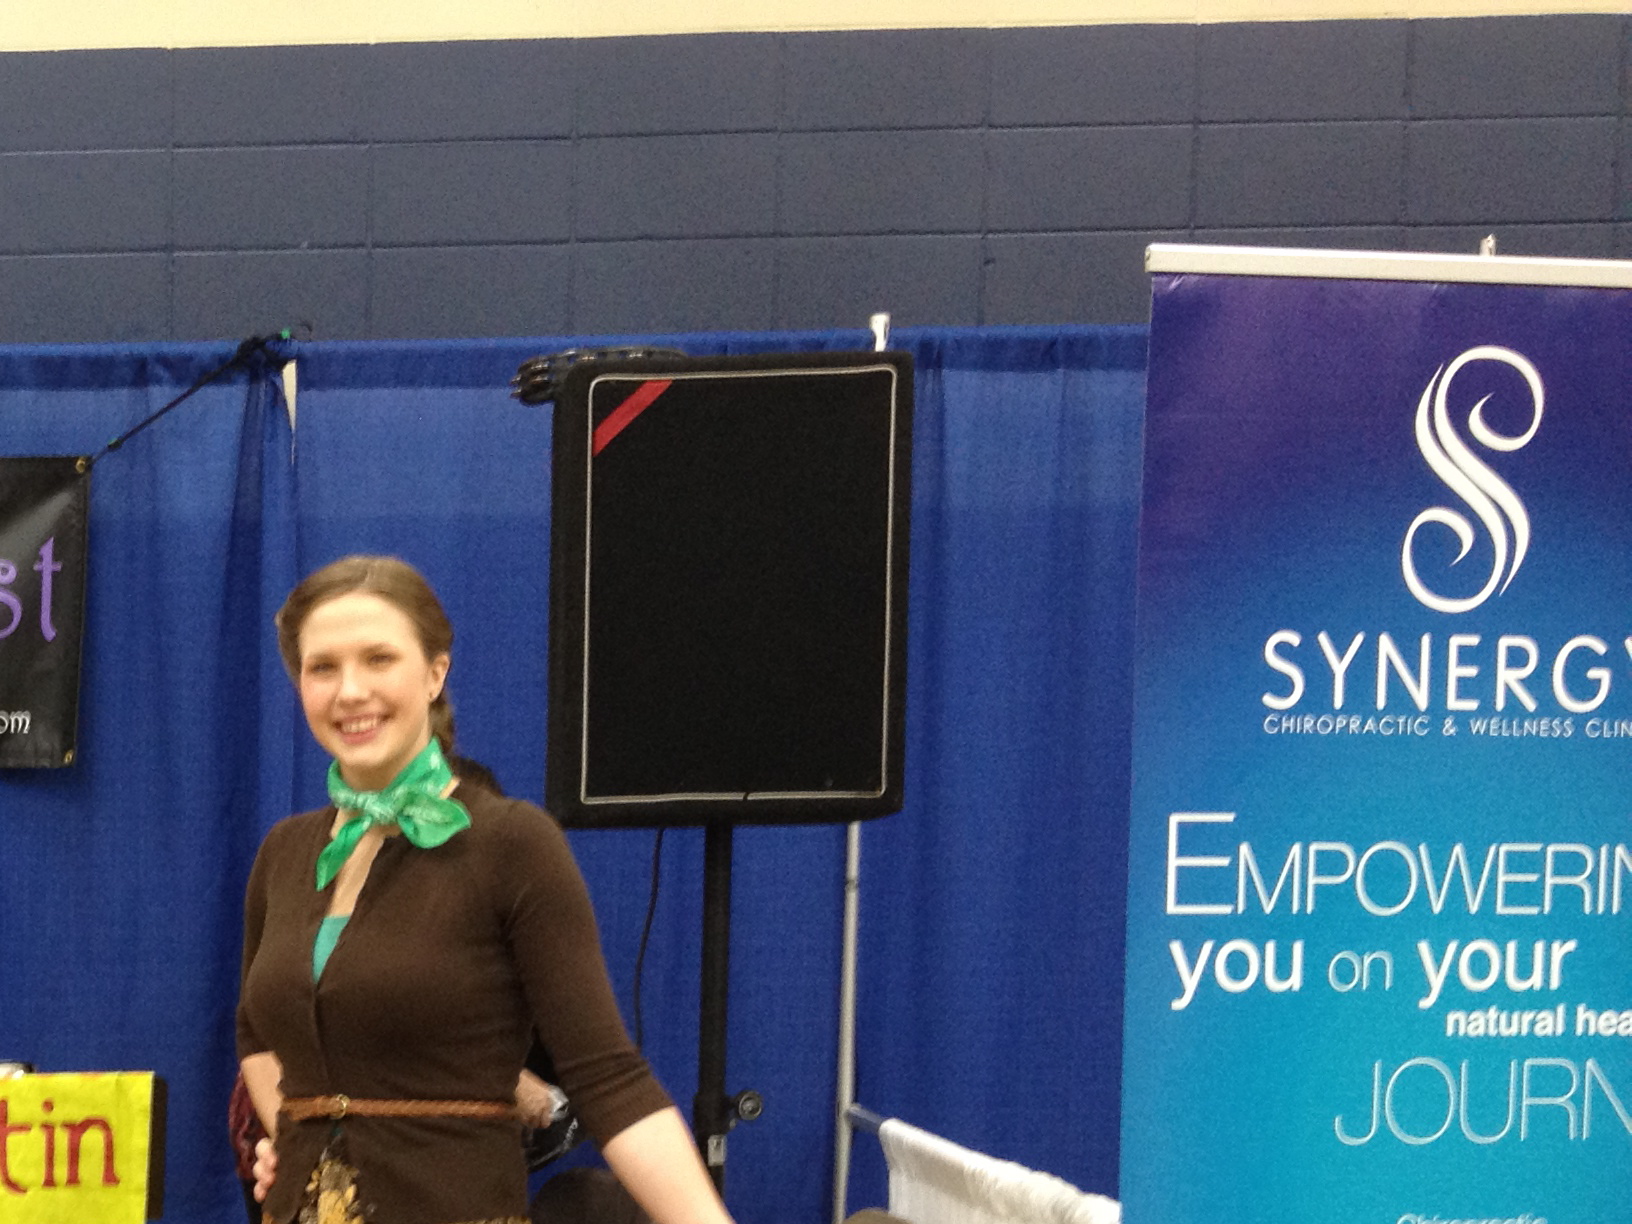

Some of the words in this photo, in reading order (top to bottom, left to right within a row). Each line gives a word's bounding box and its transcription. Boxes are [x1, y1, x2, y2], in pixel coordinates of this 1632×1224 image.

[1261, 629, 1632, 714] SYNERG
[1263, 713, 1431, 737] CHIROPRACTIC
[1441, 715, 1457, 738] &
[1469, 716, 1576, 738] WELLNESS
[1168, 936, 1305, 1012] you
[1327, 948, 1395, 994] on
[1416, 936, 1579, 1011] your
[1445, 1003, 1567, 1039] natural
